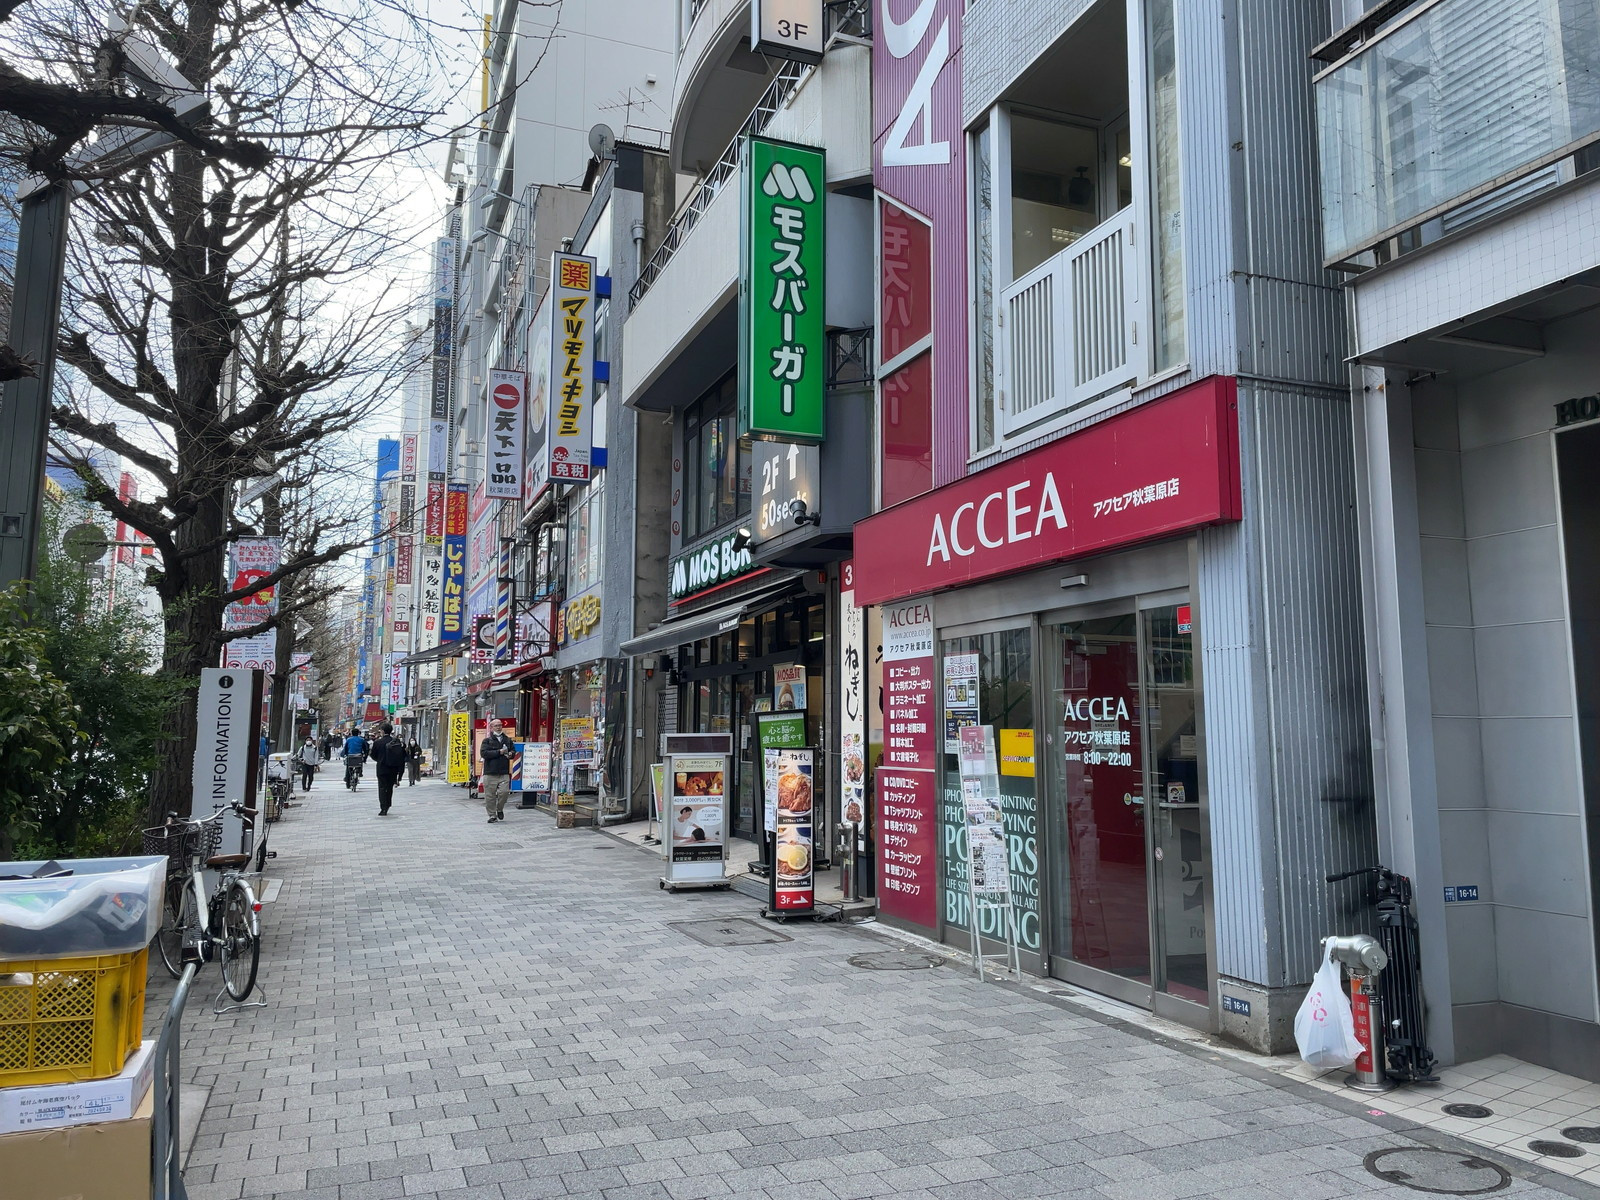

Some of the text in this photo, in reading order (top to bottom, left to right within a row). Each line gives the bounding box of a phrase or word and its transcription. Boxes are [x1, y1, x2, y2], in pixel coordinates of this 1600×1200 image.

[777, 19, 808, 41] 3F
[562, 261, 588, 289] 薬
[771, 205, 805, 415] モスバーガー
[560, 297, 588, 436] マツモトキヨシ
[493, 372, 522, 383] 中華そば
[405, 437, 415, 472] カラオケ
[491, 411, 518, 485] 天下一品
[555, 462, 585, 479] 免税
[761, 454, 780, 496] 2F
[489, 485, 519, 497] 秋葉原店
[1092, 477, 1180, 519] アクセア秋葉原店
[925, 471, 1069, 567] ACCEA
[688, 544, 720, 587] MOS
[889, 603, 932, 629] ACCEA
[394, 622, 409, 632] 3F
[890, 626, 932, 641] www.accea.co.jp
[889, 640, 932, 654] アクセア秋葉原店
[895, 665, 921, 678] コピー・出力
[895, 679, 932, 692] 大判ポスター出力
[895, 694, 927, 705] ラミネート加工
[895, 708, 919, 720] パネル加工
[1063, 696, 1130, 722] ACCEA
[212, 692, 233, 799] INFORMATION
[1063, 730, 1131, 746] アクセア秋葉原店
[889, 805, 924, 821] Tシャツプリント
[889, 834, 909, 848] デザイン
[889, 849, 922, 866] カーラッピング
[945, 877, 957, 891] LIFE
[780, 895, 791, 905] 3F
[1458, 887, 1477, 900] 16-14
[1023, 899, 1039, 911] ART
[1233, 999, 1249, 1012] 16-14
